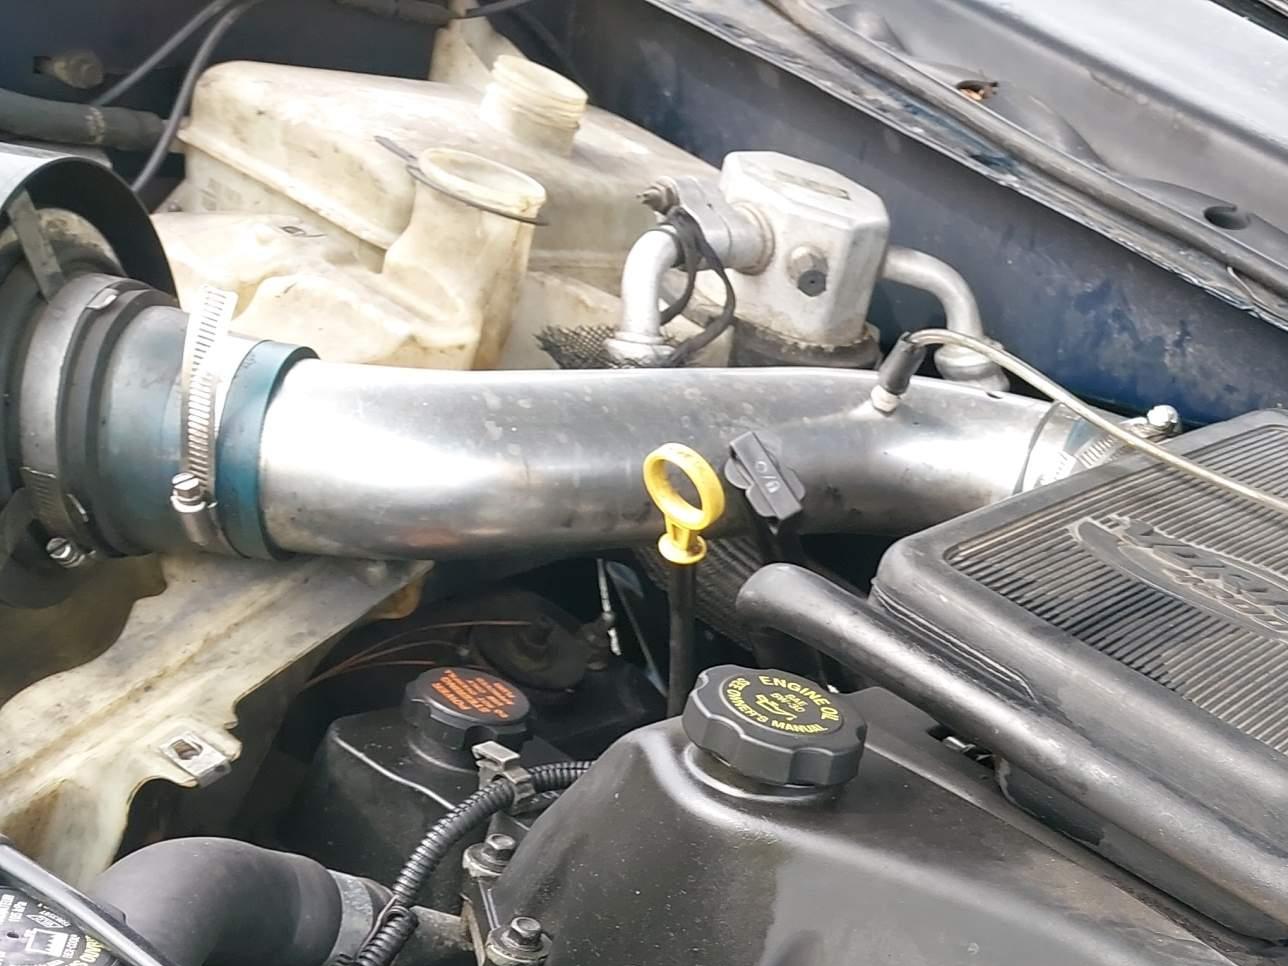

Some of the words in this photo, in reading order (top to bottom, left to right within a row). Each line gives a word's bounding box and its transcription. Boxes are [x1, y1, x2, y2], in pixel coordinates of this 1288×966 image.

[726, 688, 769, 723] OWNER'S
[771, 719, 829, 734] MANUAL
[758, 675, 831, 706] ENGINE
[820, 706, 840, 721] OIL
